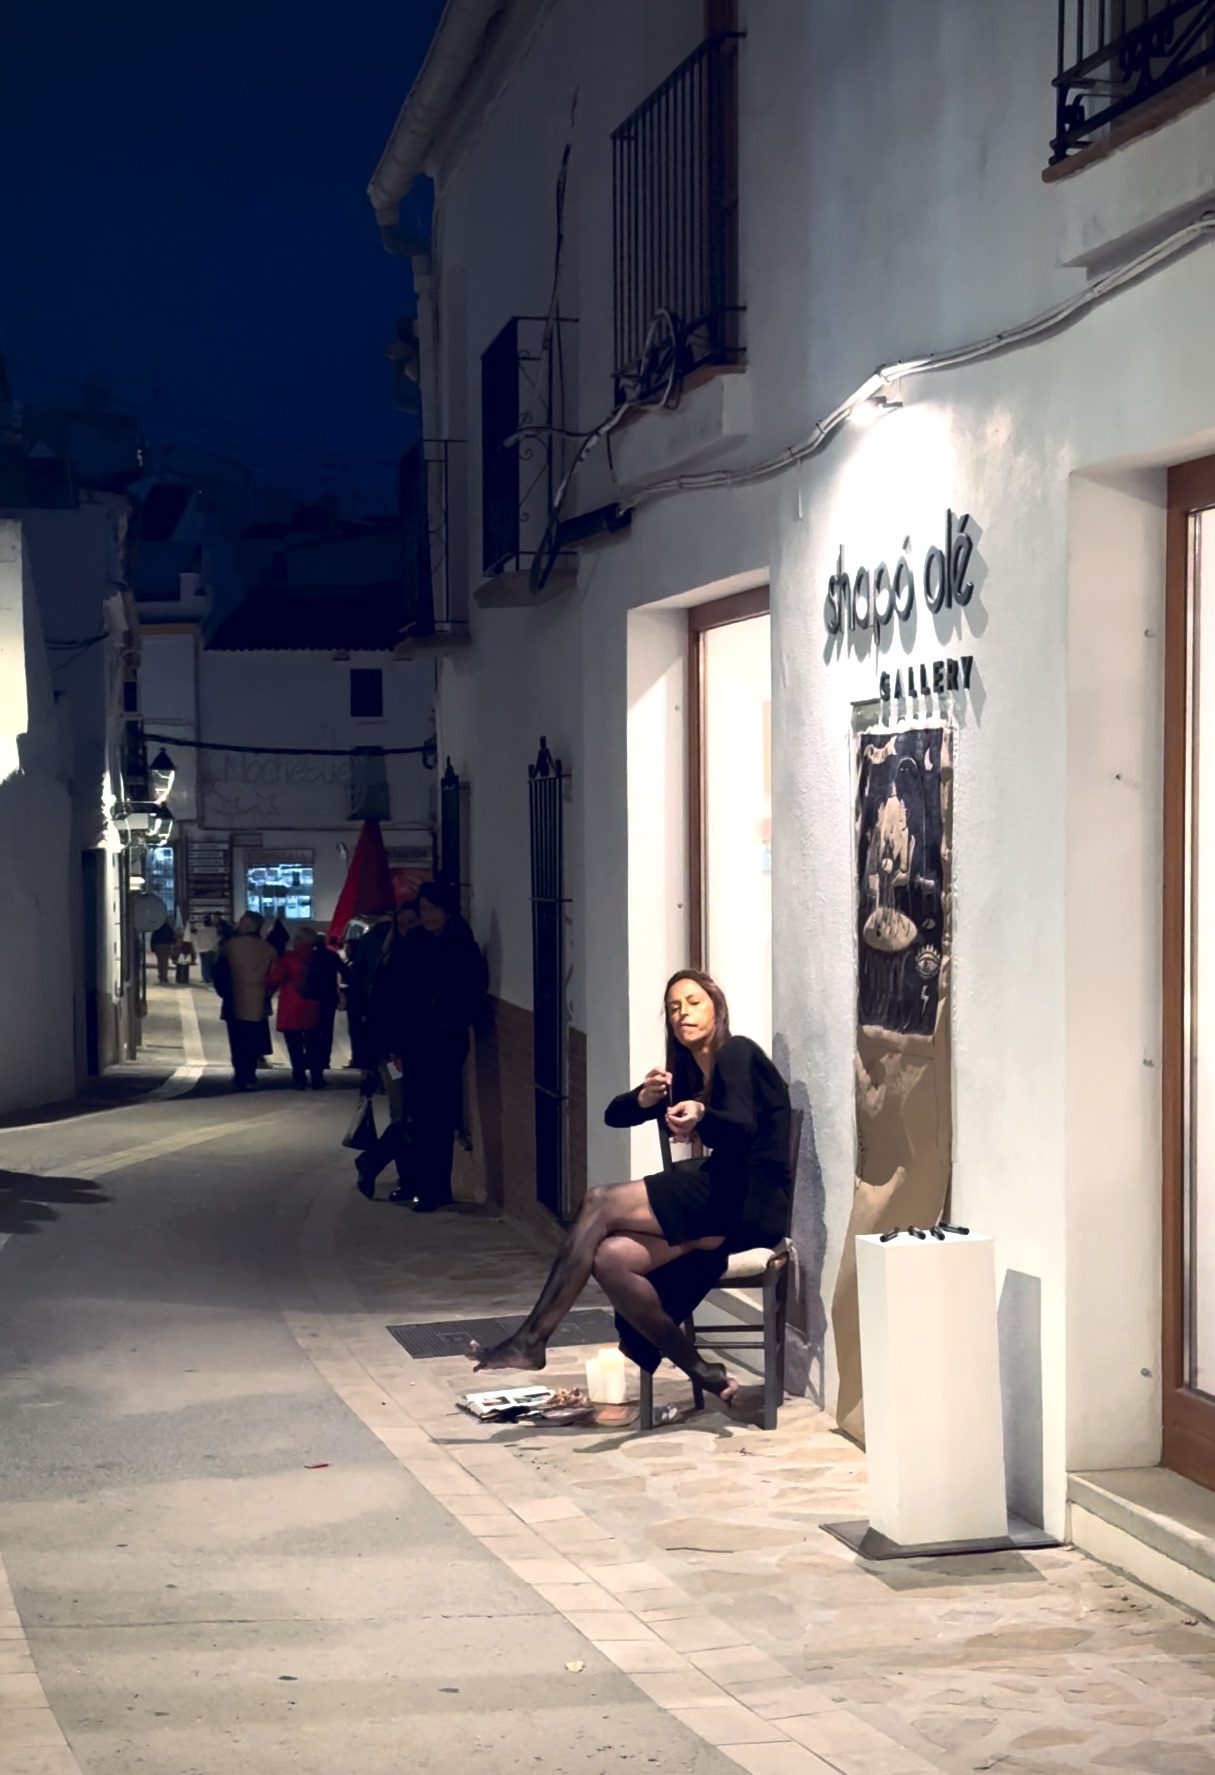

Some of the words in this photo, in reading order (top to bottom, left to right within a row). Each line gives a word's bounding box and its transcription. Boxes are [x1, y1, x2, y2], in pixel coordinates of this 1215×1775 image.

[827, 535, 915, 647] shapó
[924, 508, 974, 614] olé
[879, 655, 973, 702] GALLERY
